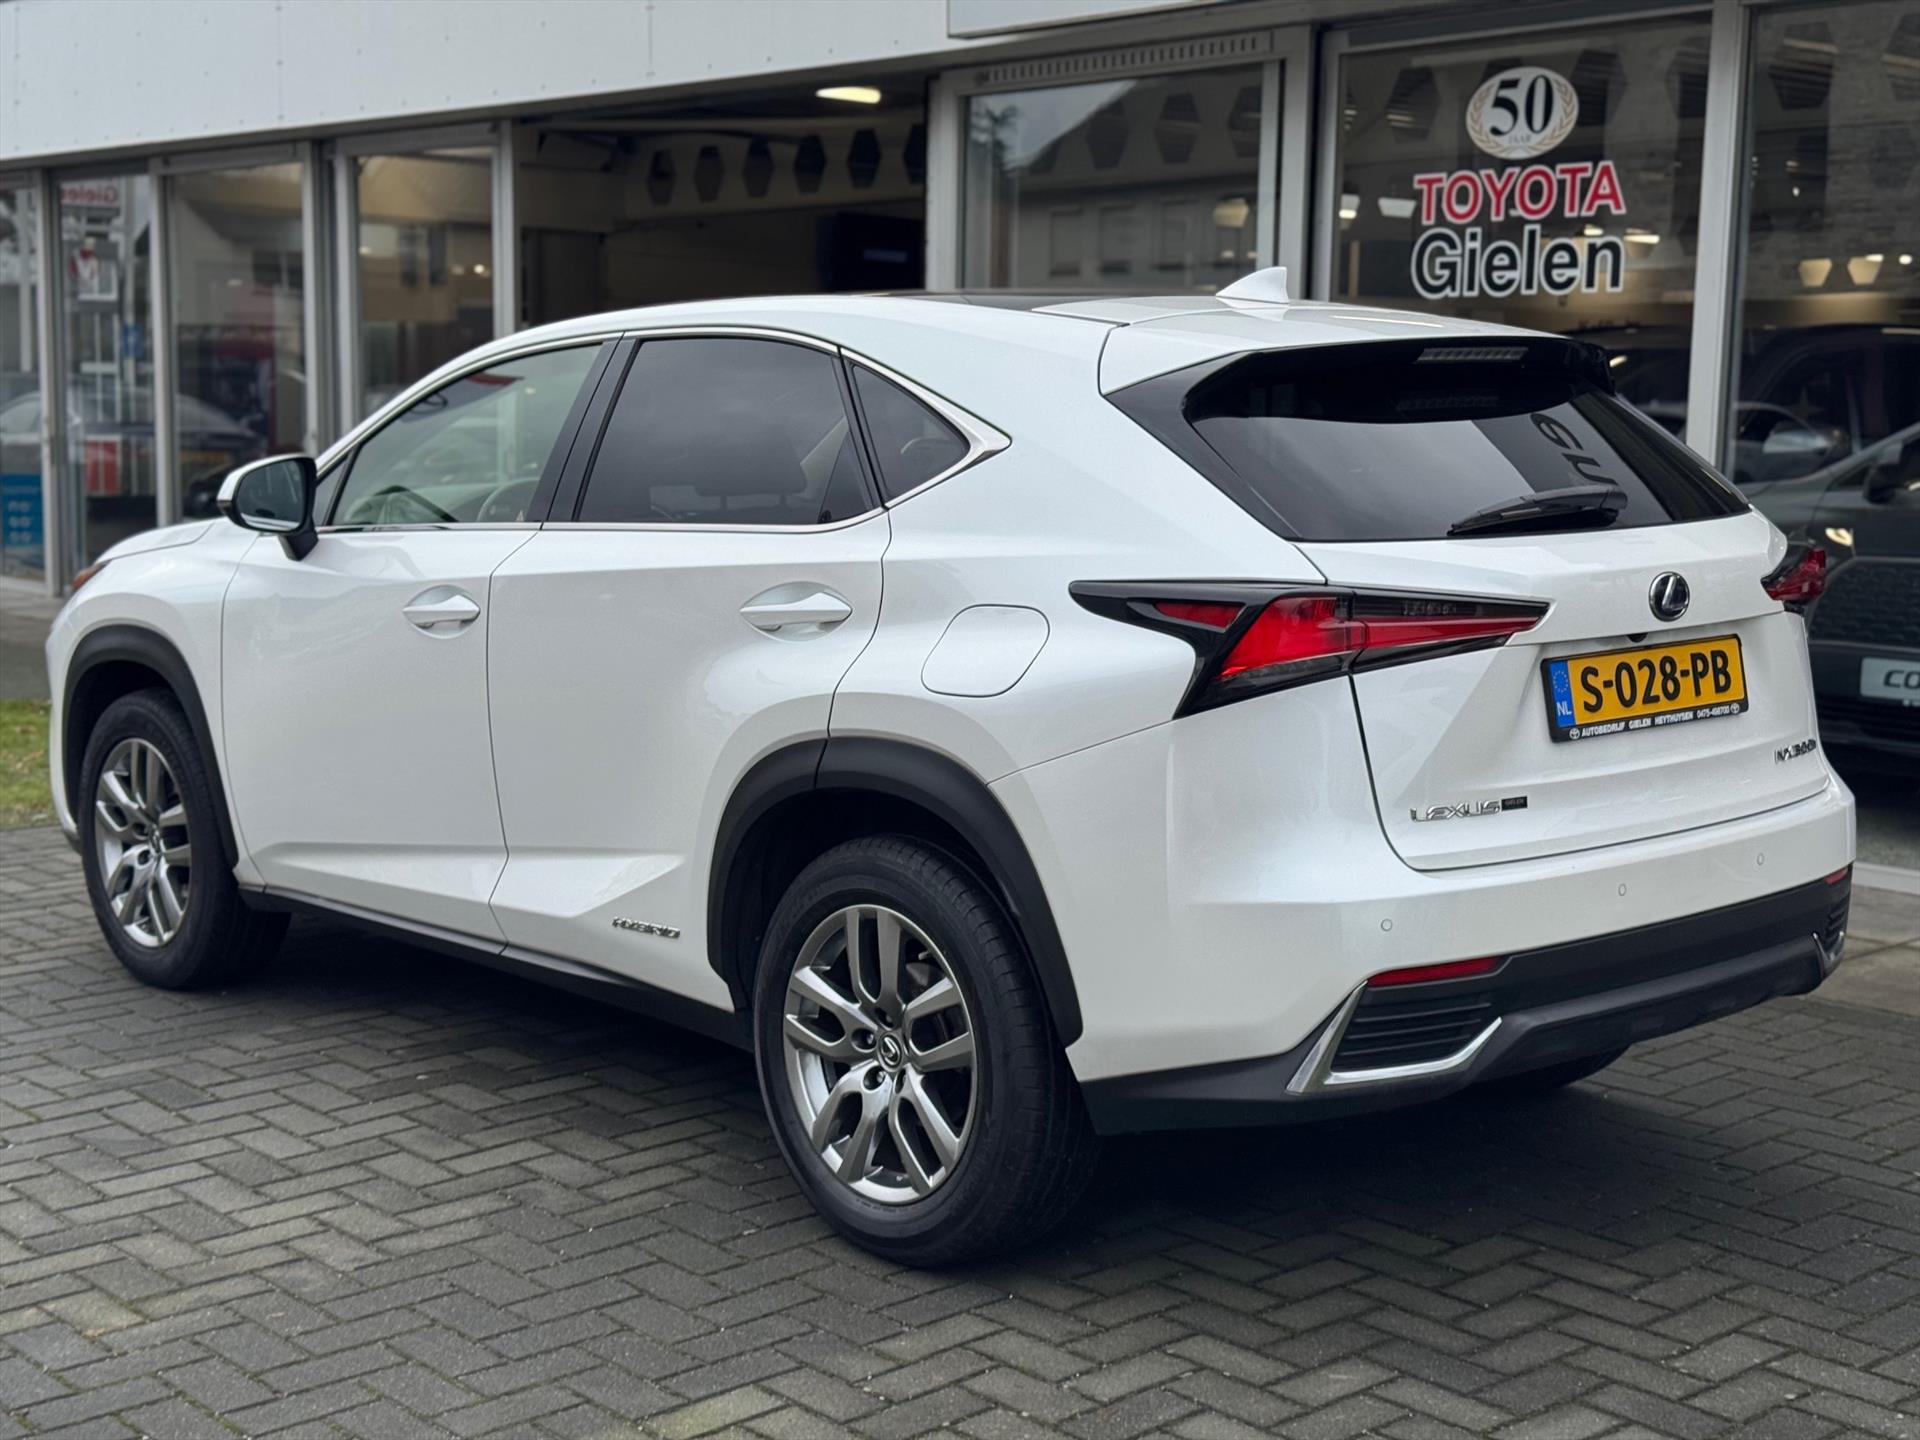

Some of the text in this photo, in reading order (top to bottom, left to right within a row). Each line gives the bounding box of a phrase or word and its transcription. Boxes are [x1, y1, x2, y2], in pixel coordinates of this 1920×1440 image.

[1489, 75, 1554, 137] 50
[1413, 160, 1627, 225] TOYOTA
[1411, 224, 1625, 300] Gielen
[1580, 649, 1732, 713] S-028-PB
[1556, 702, 1572, 716] NL
[1581, 721, 1626, 737] AUTOBEDRIJF
[1628, 717, 1652, 730] GIELEN
[1410, 800, 1500, 822] LEXUS
[612, 916, 681, 939] HYBRID
